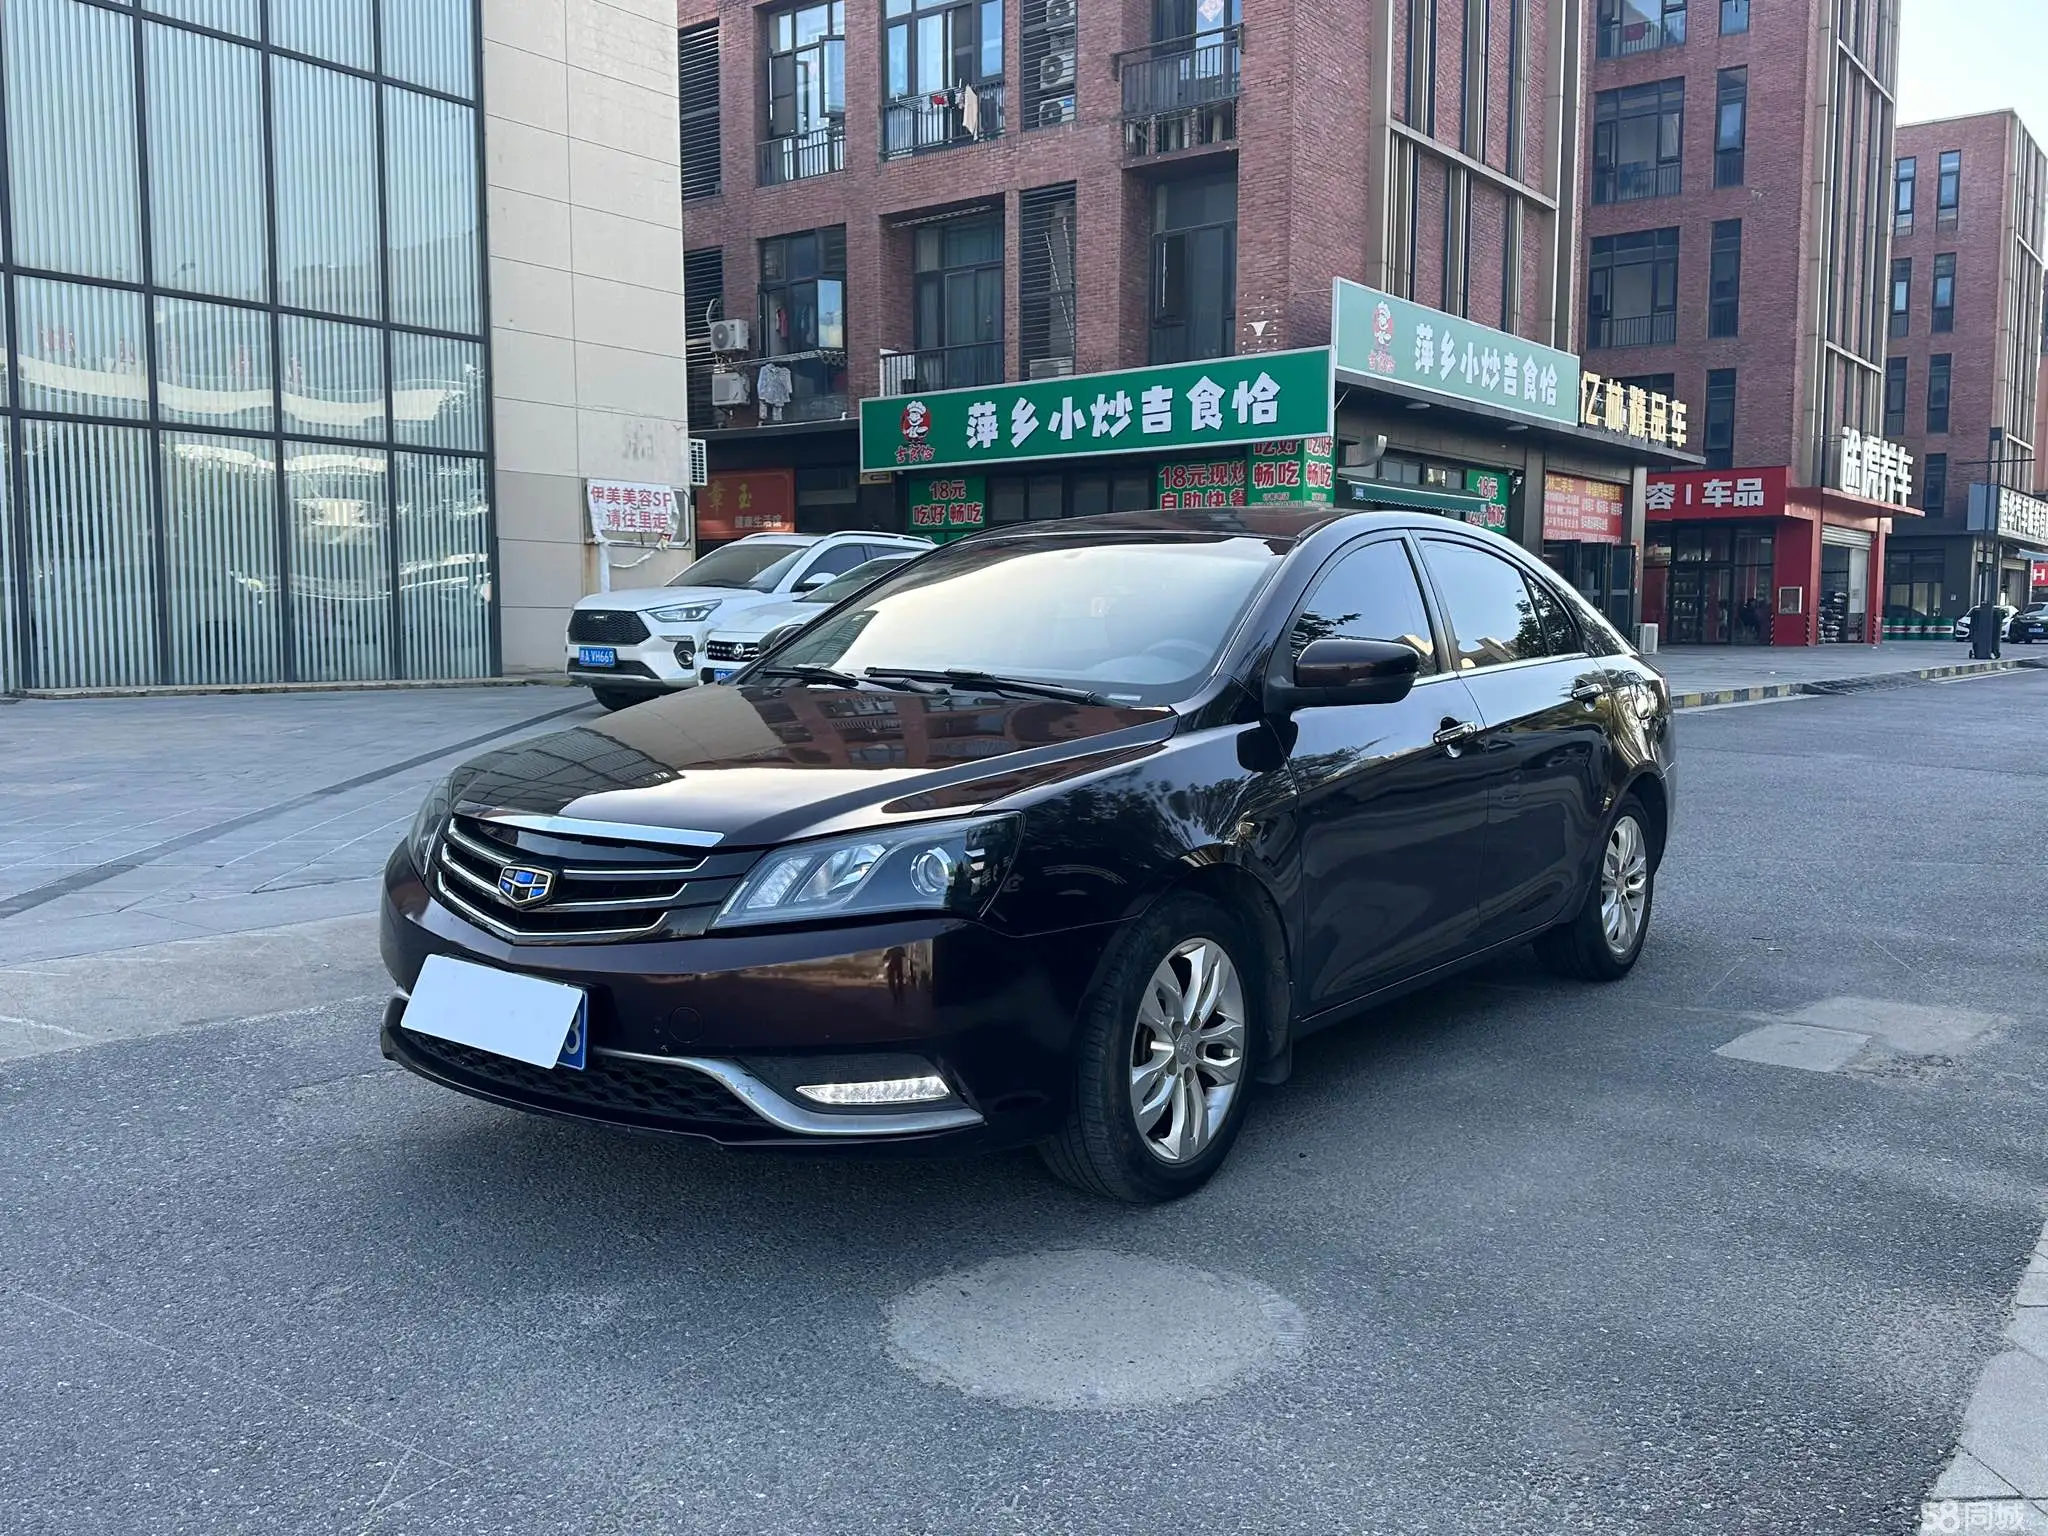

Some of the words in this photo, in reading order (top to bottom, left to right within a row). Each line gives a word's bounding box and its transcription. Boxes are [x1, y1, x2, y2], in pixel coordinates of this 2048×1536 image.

[1415, 323, 1558, 406] 萍乡小炒吉食恰
[966, 371, 1280, 449] 萍乡小炒吉食恰
[1159, 460, 1245, 489] 18元现炒
[1252, 460, 1301, 489] 畅吃
[1306, 459, 1334, 489] 畅吃
[1839, 426, 1914, 507] 途虎养车
[929, 480, 967, 500] 18元
[1477, 476, 1498, 499] 18元
[1646, 482, 1675, 511] 容
[1702, 478, 1764, 508] 车品
[606, 509, 668, 532] 请往里走
[913, 504, 946, 526] 吃好
[948, 502, 984, 525] 畅吃
